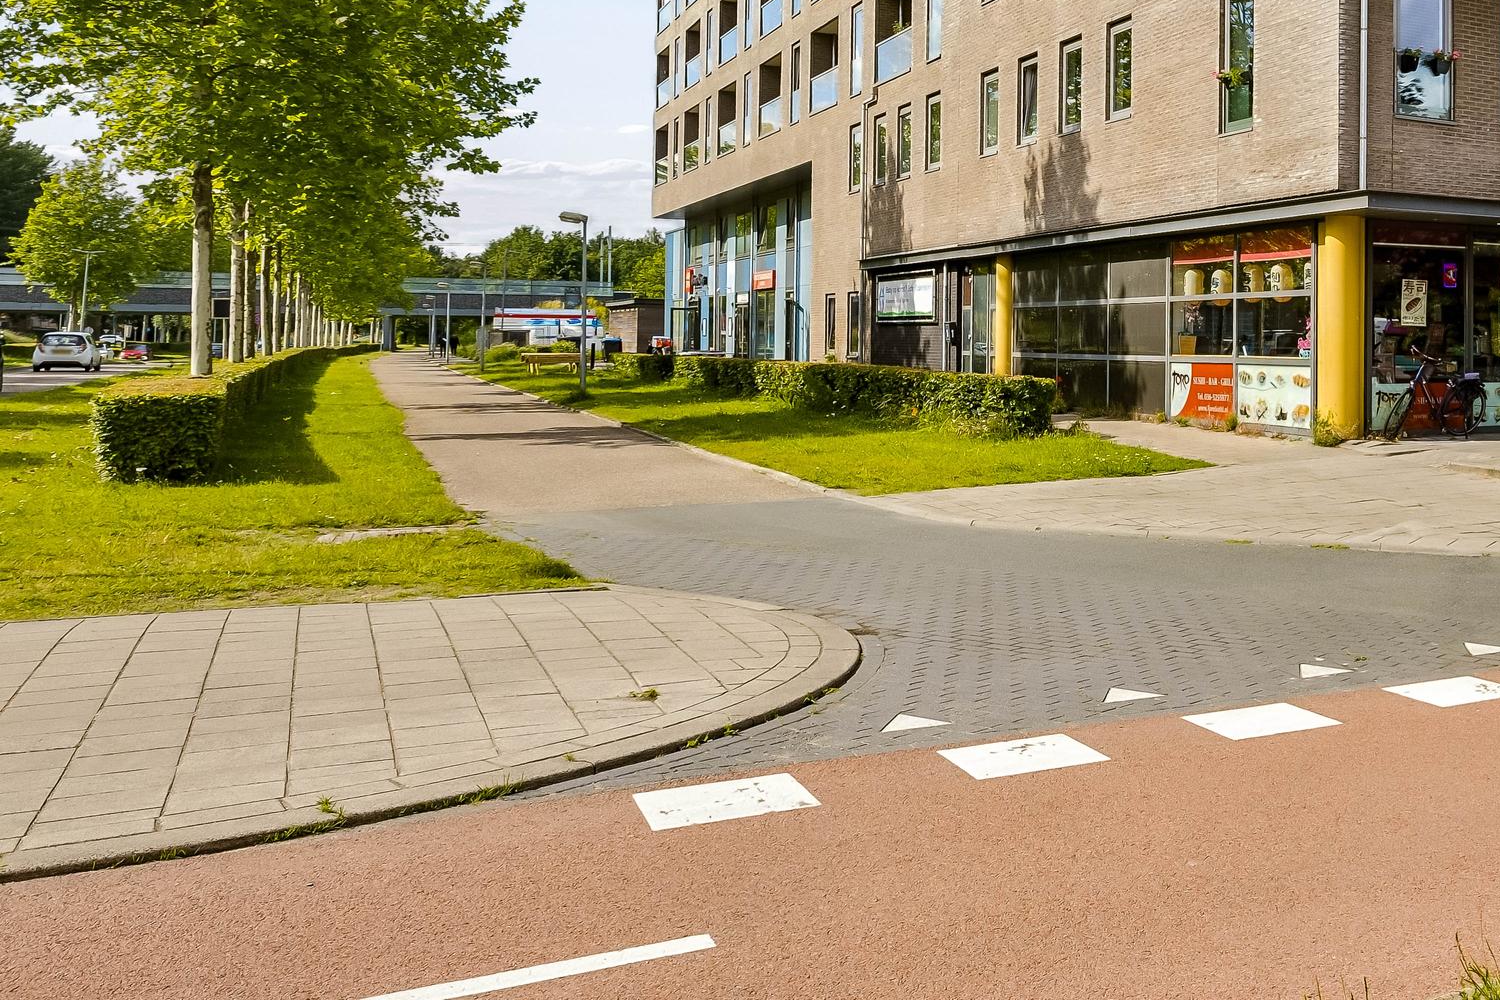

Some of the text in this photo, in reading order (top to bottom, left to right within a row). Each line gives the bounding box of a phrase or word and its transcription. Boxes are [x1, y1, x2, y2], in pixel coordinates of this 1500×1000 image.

[1403, 280, 1427, 295] 寿司
[1172, 370, 1190, 398] TORO
[1192, 376, 1206, 385] SUSHI
[1208, 377, 1218, 386] BAR
